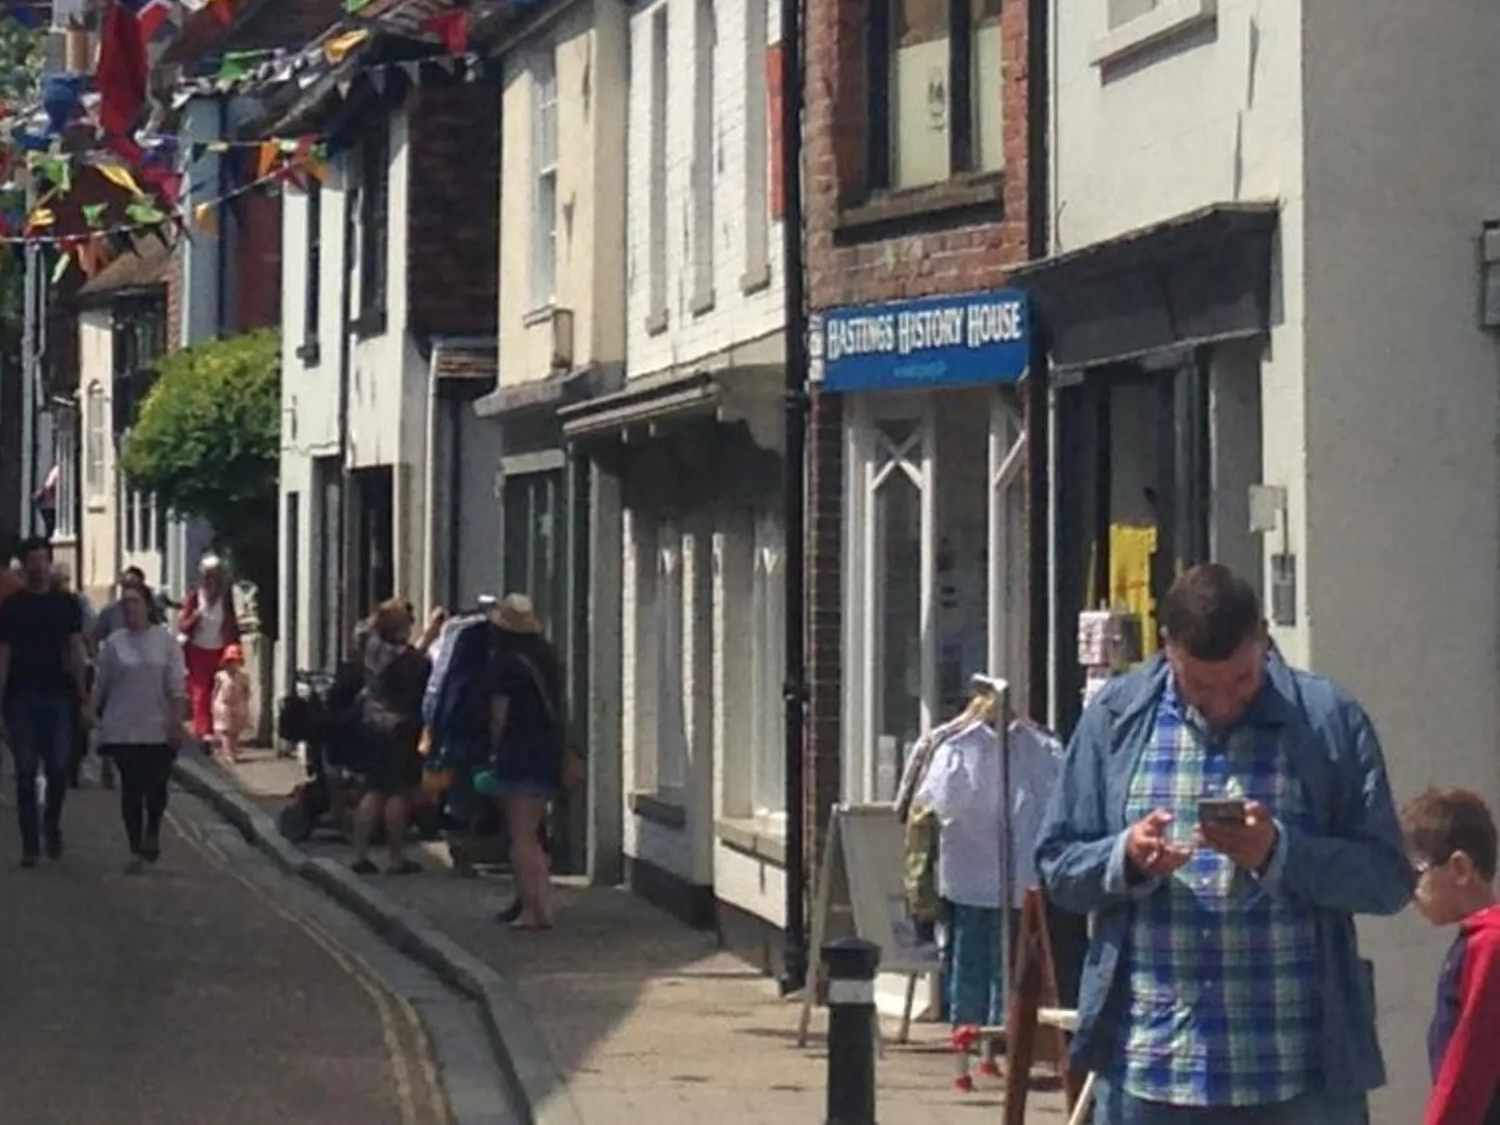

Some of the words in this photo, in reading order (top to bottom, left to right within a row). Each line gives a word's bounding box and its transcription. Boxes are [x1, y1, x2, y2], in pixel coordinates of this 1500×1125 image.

[827, 315, 895, 360] HASTINGS
[898, 308, 964, 354] HISTORY
[967, 301, 1021, 347] HOUSE
